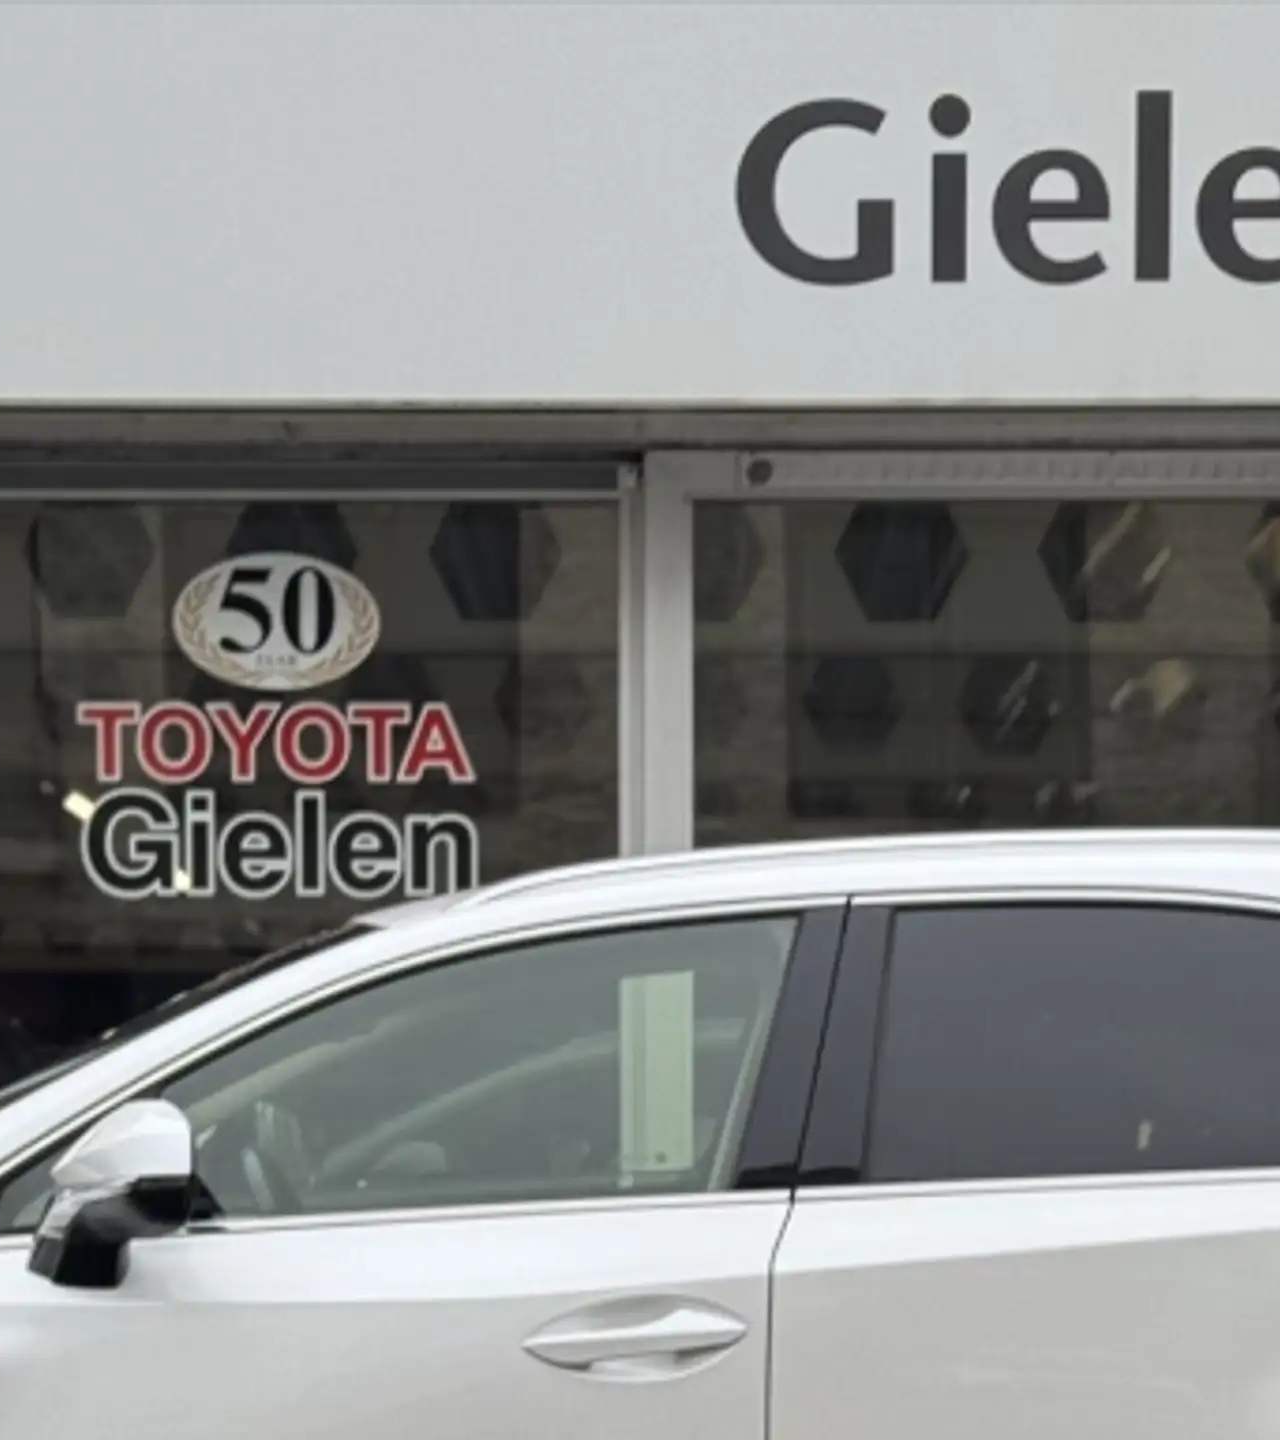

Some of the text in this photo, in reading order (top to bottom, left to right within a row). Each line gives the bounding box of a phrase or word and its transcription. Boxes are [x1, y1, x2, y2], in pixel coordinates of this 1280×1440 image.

[219, 565, 335, 654] 50
[77, 702, 476, 782] TOYOTA
[81, 788, 479, 899] Gielen
